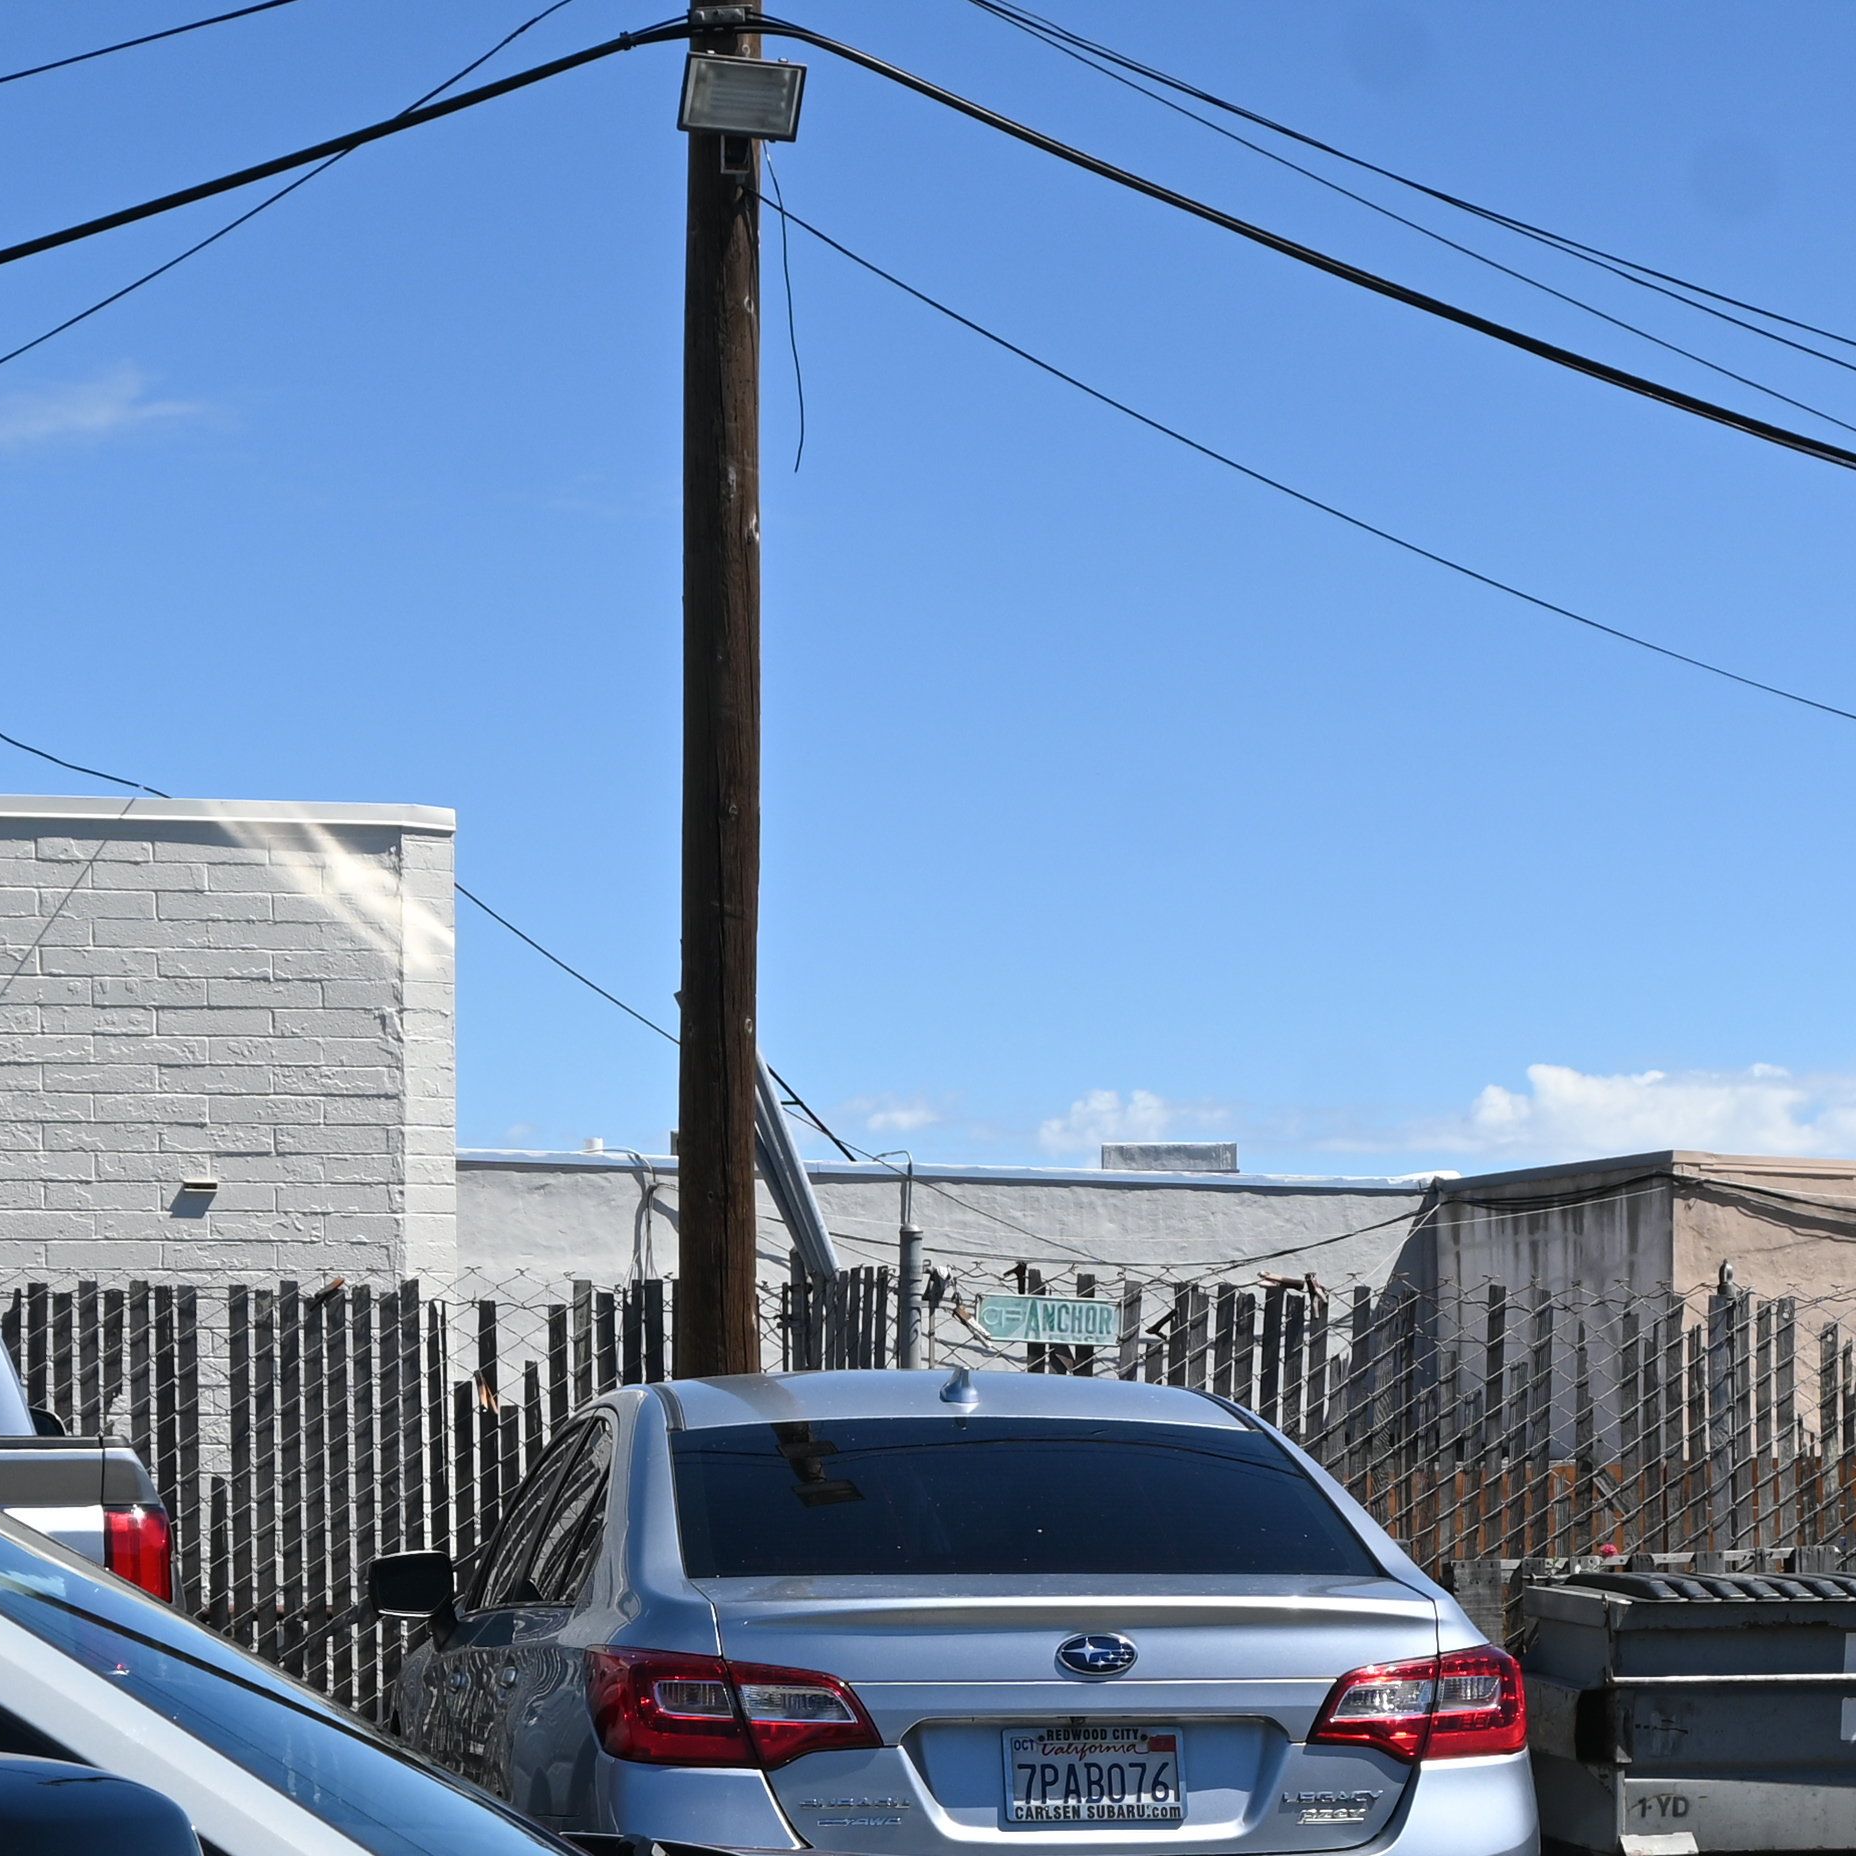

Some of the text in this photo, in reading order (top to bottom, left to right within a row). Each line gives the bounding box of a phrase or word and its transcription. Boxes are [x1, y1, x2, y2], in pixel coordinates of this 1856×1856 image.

[1024, 1300, 1113, 1340] ANCHOR
[1046, 1728, 1140, 1742] REDWOOD CITY
[1013, 1739, 1139, 1762] OCT California
[1016, 1762, 1171, 1805] 7PAB076
[1014, 1804, 1182, 1820] CARLSEN SUBARU.com
